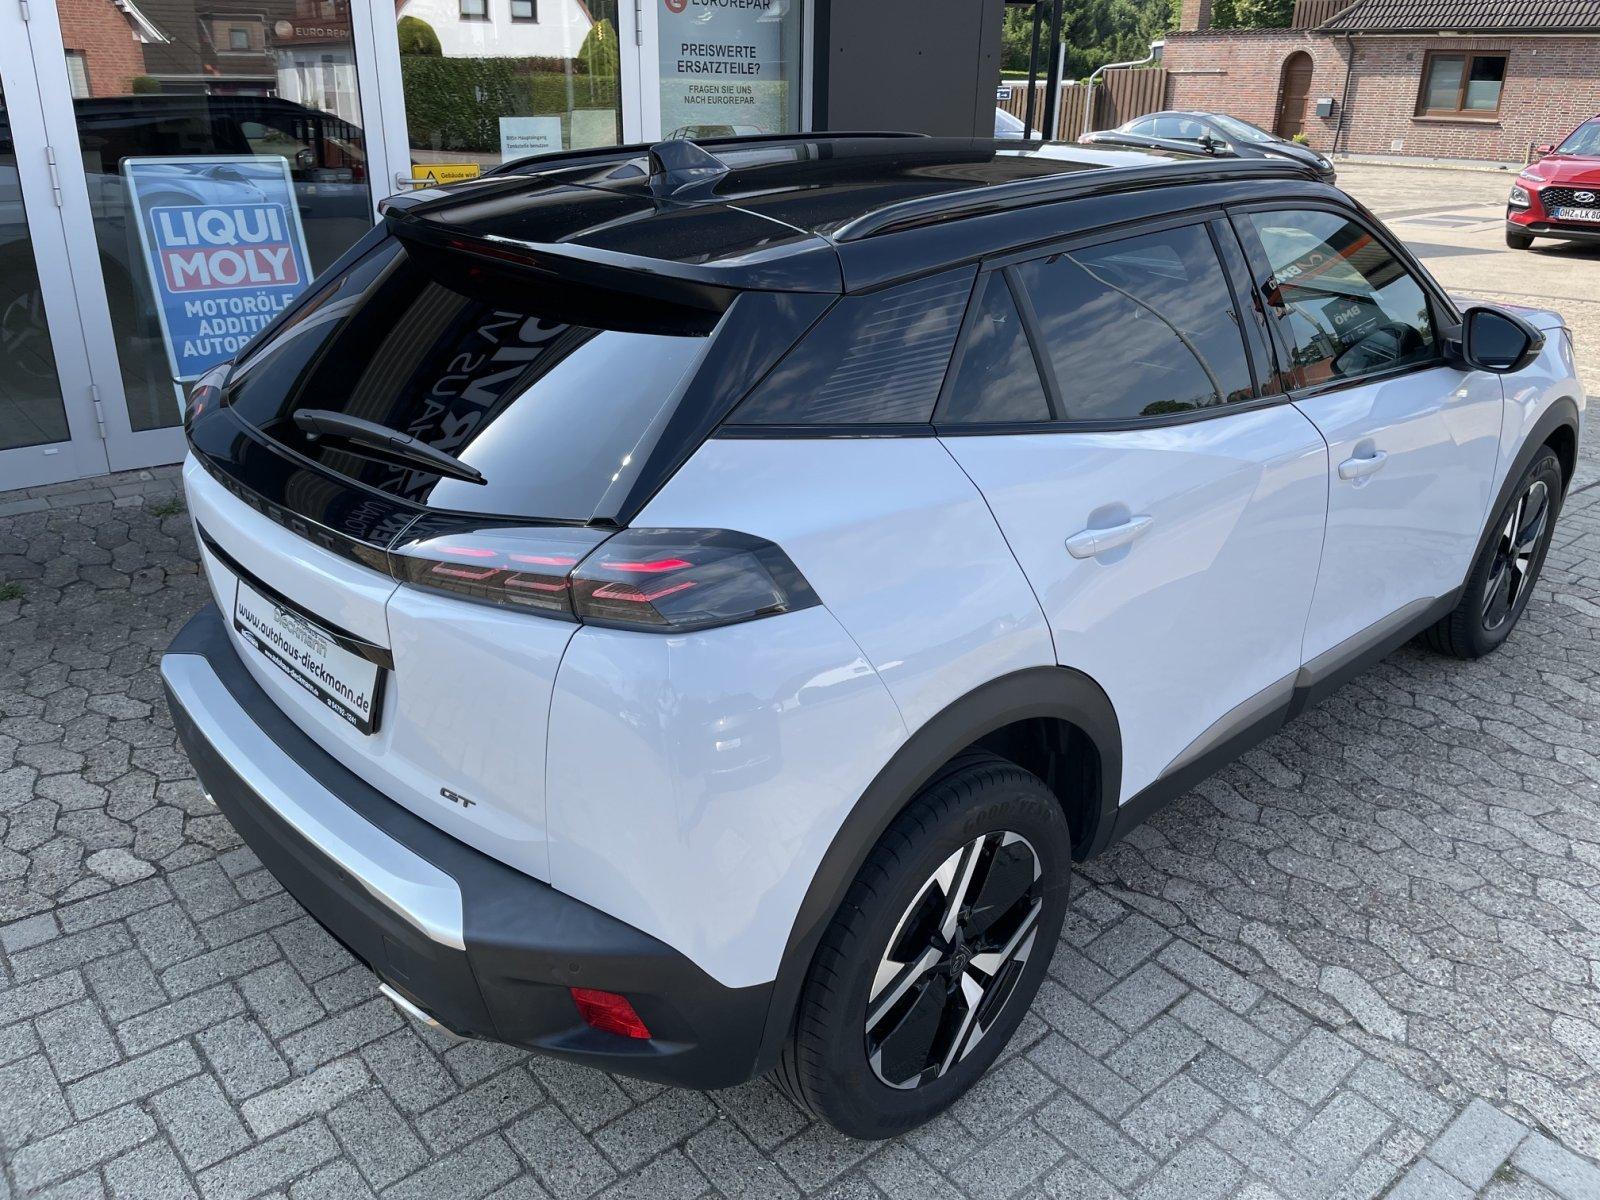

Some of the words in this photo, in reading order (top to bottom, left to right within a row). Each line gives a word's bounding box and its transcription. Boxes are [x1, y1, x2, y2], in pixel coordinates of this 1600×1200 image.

[681, 43, 757, 58] PREISWERTE
[677, 60, 761, 74] ERSATZTEILE?
[689, 85, 719, 94] FRAGEN
[721, 86, 734, 94] SIE
[736, 86, 752, 94] UNS
[684, 96, 706, 104] NACH
[440, 171, 464, 179] Gebäude
[1560, 209, 1575, 218] OHZ
[1580, 210, 1590, 219] LK
[159, 208, 283, 246] LIQUI
[168, 247, 289, 288] MOLY
[184, 291, 294, 318] MOTORÖLE
[238, 602, 369, 713] www.autohaus-dieckmann.de
[440, 787, 476, 808] GT
